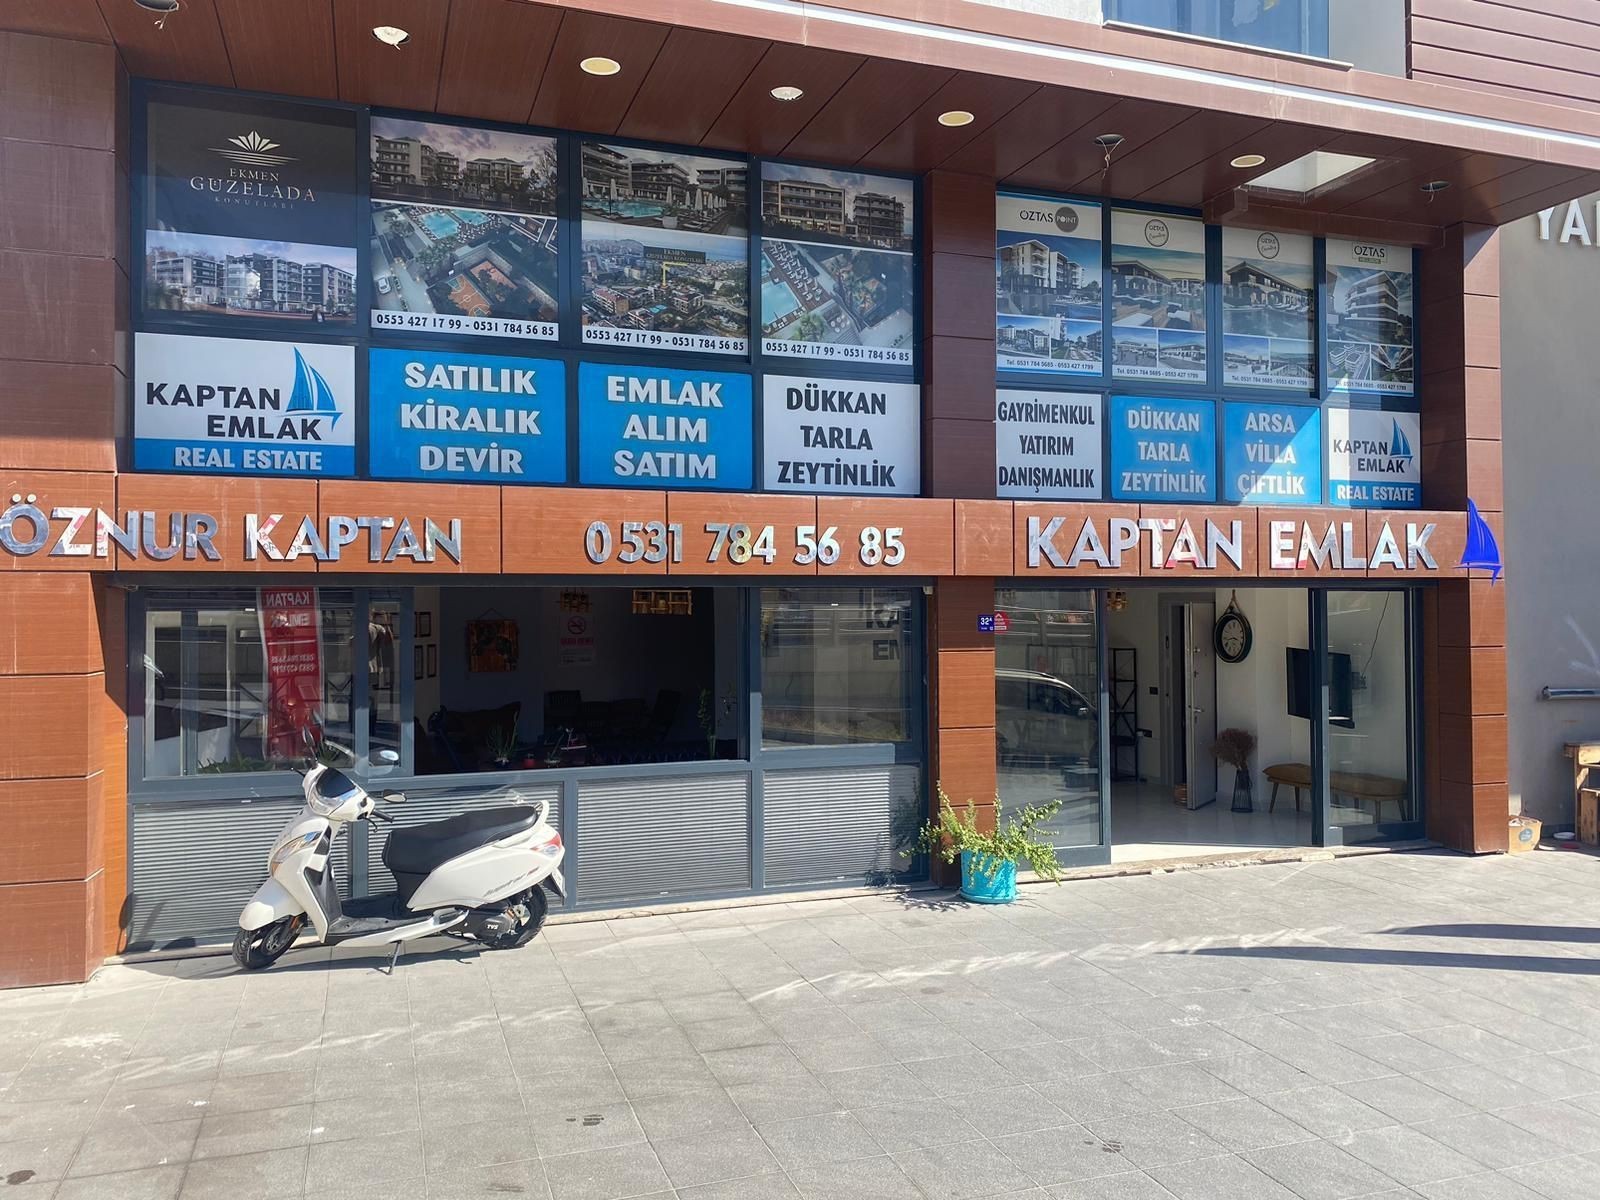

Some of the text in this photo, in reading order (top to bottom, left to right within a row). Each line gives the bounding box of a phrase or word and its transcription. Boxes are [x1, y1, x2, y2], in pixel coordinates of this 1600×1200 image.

[229, 168, 280, 182] EKMEN
[190, 176, 316, 202] GÜZELADA
[376, 313, 404, 325] 0553
[407, 315, 428, 327] 427
[432, 317, 445, 328] 17
[448, 318, 462, 330] 99
[473, 320, 498, 332] 0531
[503, 322, 523, 334] 784
[525, 324, 539, 335] 56
[541, 325, 555, 336] 85
[585, 329, 611, 340] 0553
[613, 331, 632, 342] 427
[635, 333, 647, 344] 17
[650, 334, 662, 345] 99
[672, 336, 695, 347] 0531
[698, 338, 716, 350] 784
[718, 339, 730, 350] 56
[732, 340, 744, 351] 85
[766, 342, 788, 353] 0553
[790, 344, 807, 355] 427
[811, 345, 821, 356] 17
[823, 346, 835, 356] 99
[843, 348, 864, 358] 0531
[867, 349, 883, 360] 784
[886, 350, 897, 361] 56
[898, 351, 910, 362] 85
[404, 362, 537, 395] SATILIK
[607, 375, 724, 408] EMLAK
[146, 382, 281, 411] KAPTAN
[785, 382, 887, 416] DÜKKAN
[400, 398, 542, 435] KİRALIK
[997, 398, 1095, 426] GAYRİMENKUL
[1127, 405, 1200, 433] DÜKKAN
[1245, 412, 1296, 434] ARSA
[207, 414, 322, 441] EMLAK
[622, 414, 707, 443] ALIM
[799, 424, 874, 451] TARLA
[174, 446, 323, 471] REAL ESTATE
[419, 442, 524, 474] DEVİR
[1019, 434, 1074, 456] YATIRIM
[1137, 441, 1191, 463] TARLA
[1245, 439, 1297, 465] VİLLA
[1333, 438, 1389, 456] KAPTAN
[614, 449, 716, 480] SATIM
[777, 457, 896, 487] ZEYTİNLİK
[1357, 457, 1406, 474] EMLAK
[998, 465, 1095, 493] DANIŞMANLIK
[1121, 468, 1207, 494] ZEYTİNLİK
[1237, 471, 1305, 497] ÇİFTLİK
[1336, 484, 1415, 502] REAL ESTATE
[0, 493, 222, 561] ÖZNUR
[245, 512, 463, 564] KAPTAN
[704, 522, 777, 565] 784
[794, 525, 841, 566] 56
[857, 526, 906, 566] 85
[1026, 515, 1440, 571] KAPTAN EMLAK
